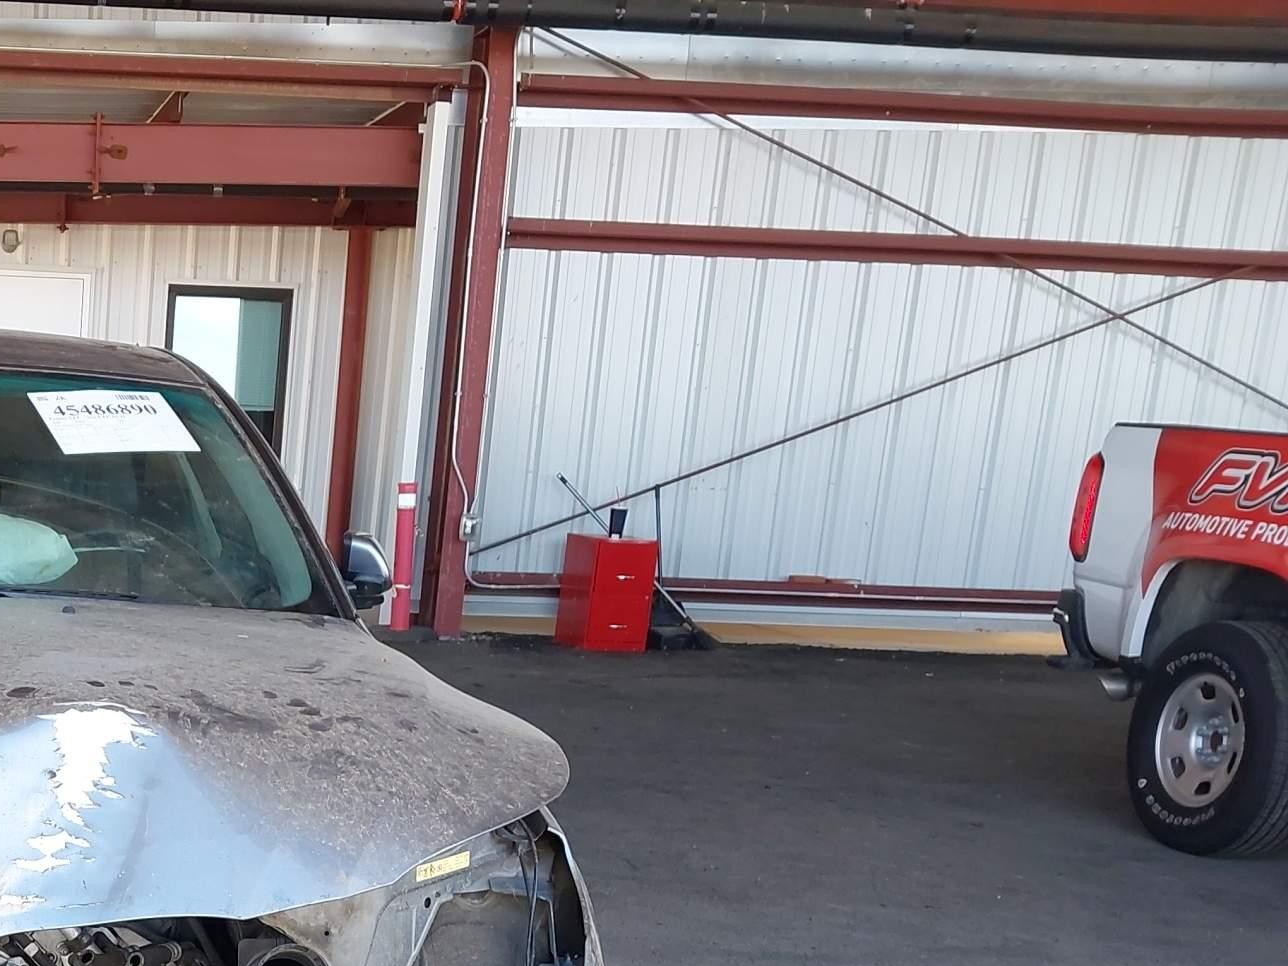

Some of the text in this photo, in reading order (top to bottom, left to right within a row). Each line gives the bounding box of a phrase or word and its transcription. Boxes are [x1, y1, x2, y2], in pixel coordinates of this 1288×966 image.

[53, 404, 158, 417] 45486890
[1187, 447, 1288, 515] FV
[1161, 511, 1254, 539] AUTOMOTIVE
